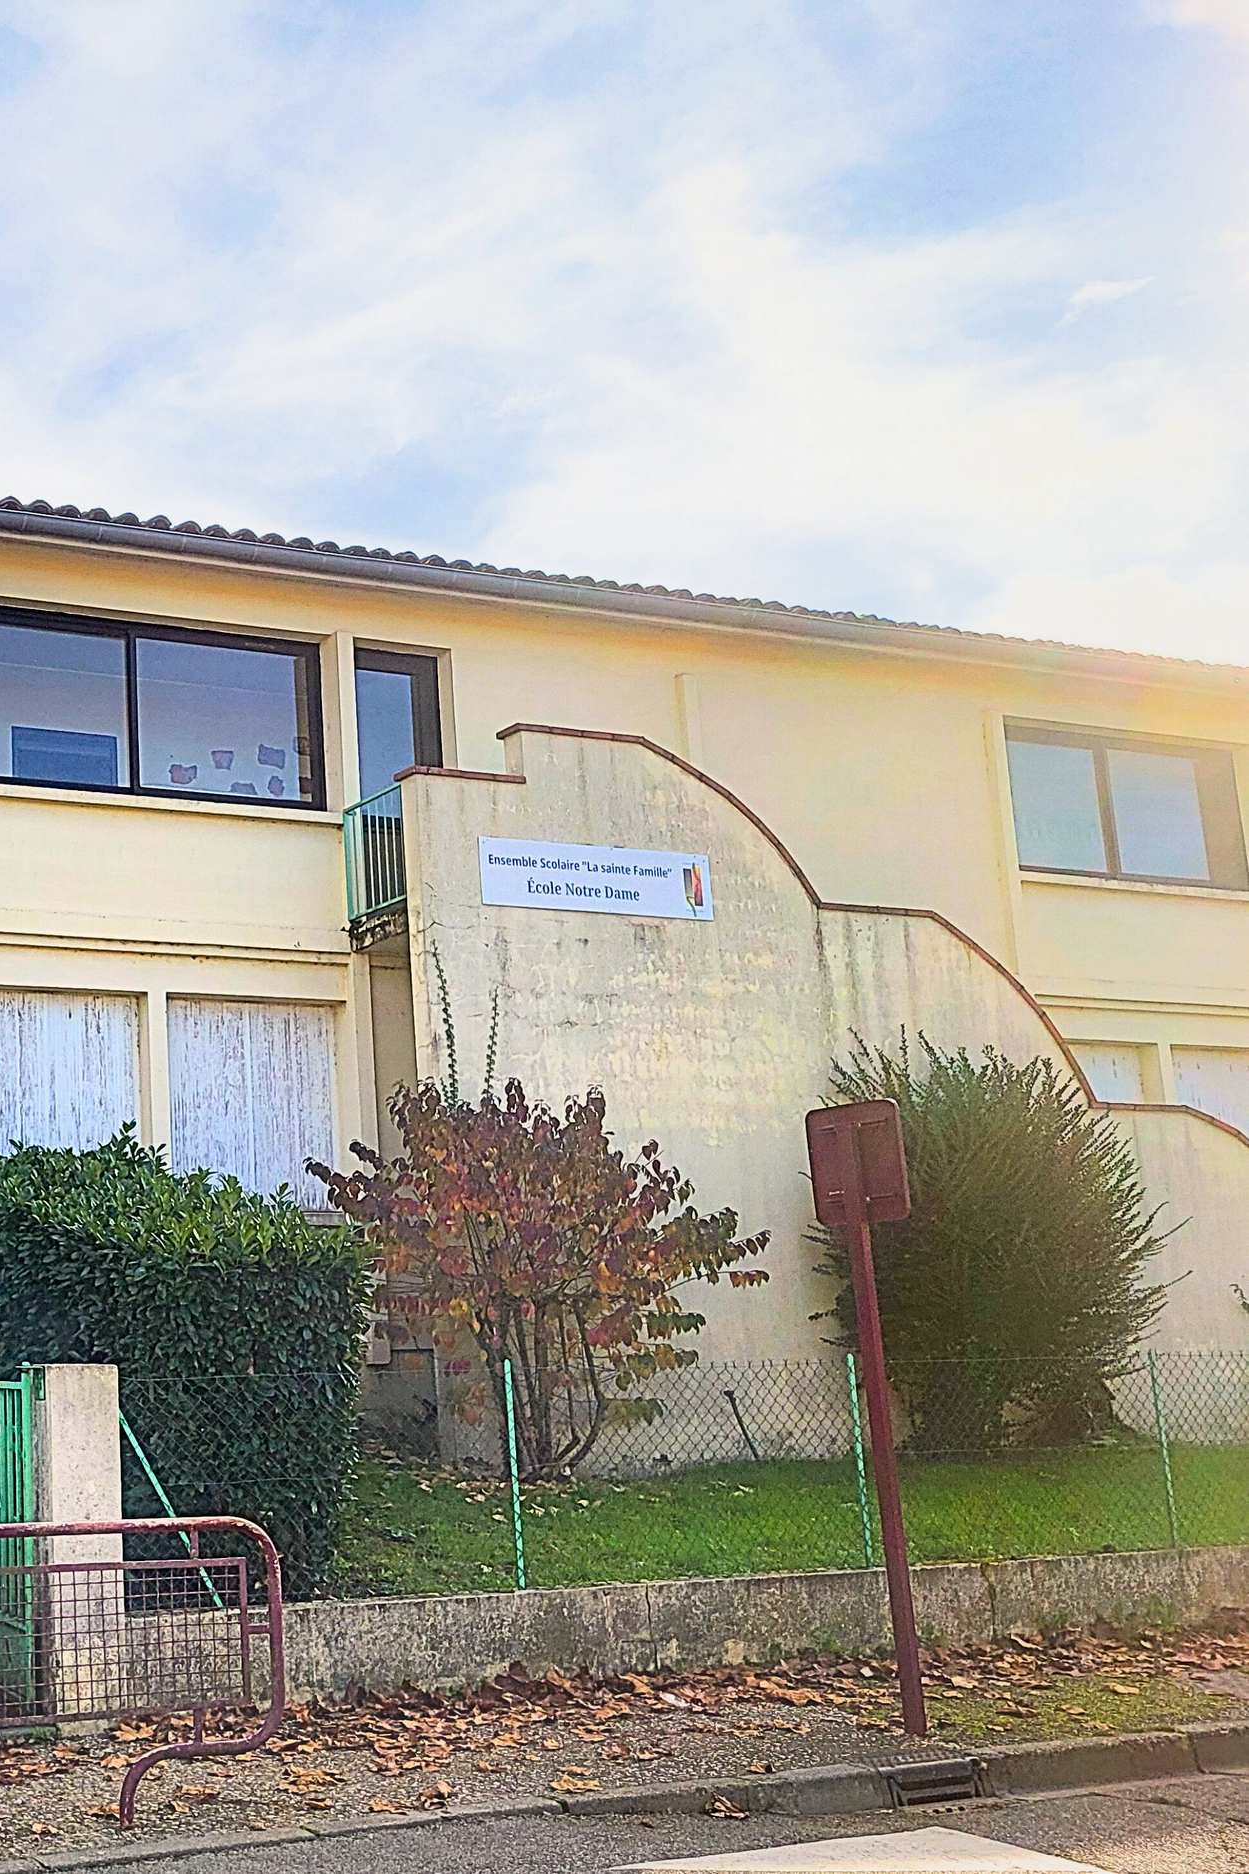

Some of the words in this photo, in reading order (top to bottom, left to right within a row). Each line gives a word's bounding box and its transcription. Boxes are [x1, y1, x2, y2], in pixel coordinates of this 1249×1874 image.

[488, 854, 538, 868] Ensemble
[540, 857, 580, 871] Scolaire
[601, 863, 631, 875] sainte
[527, 876, 562, 895] École
[565, 883, 601, 898] Notre
[604, 885, 640, 901] Dame
